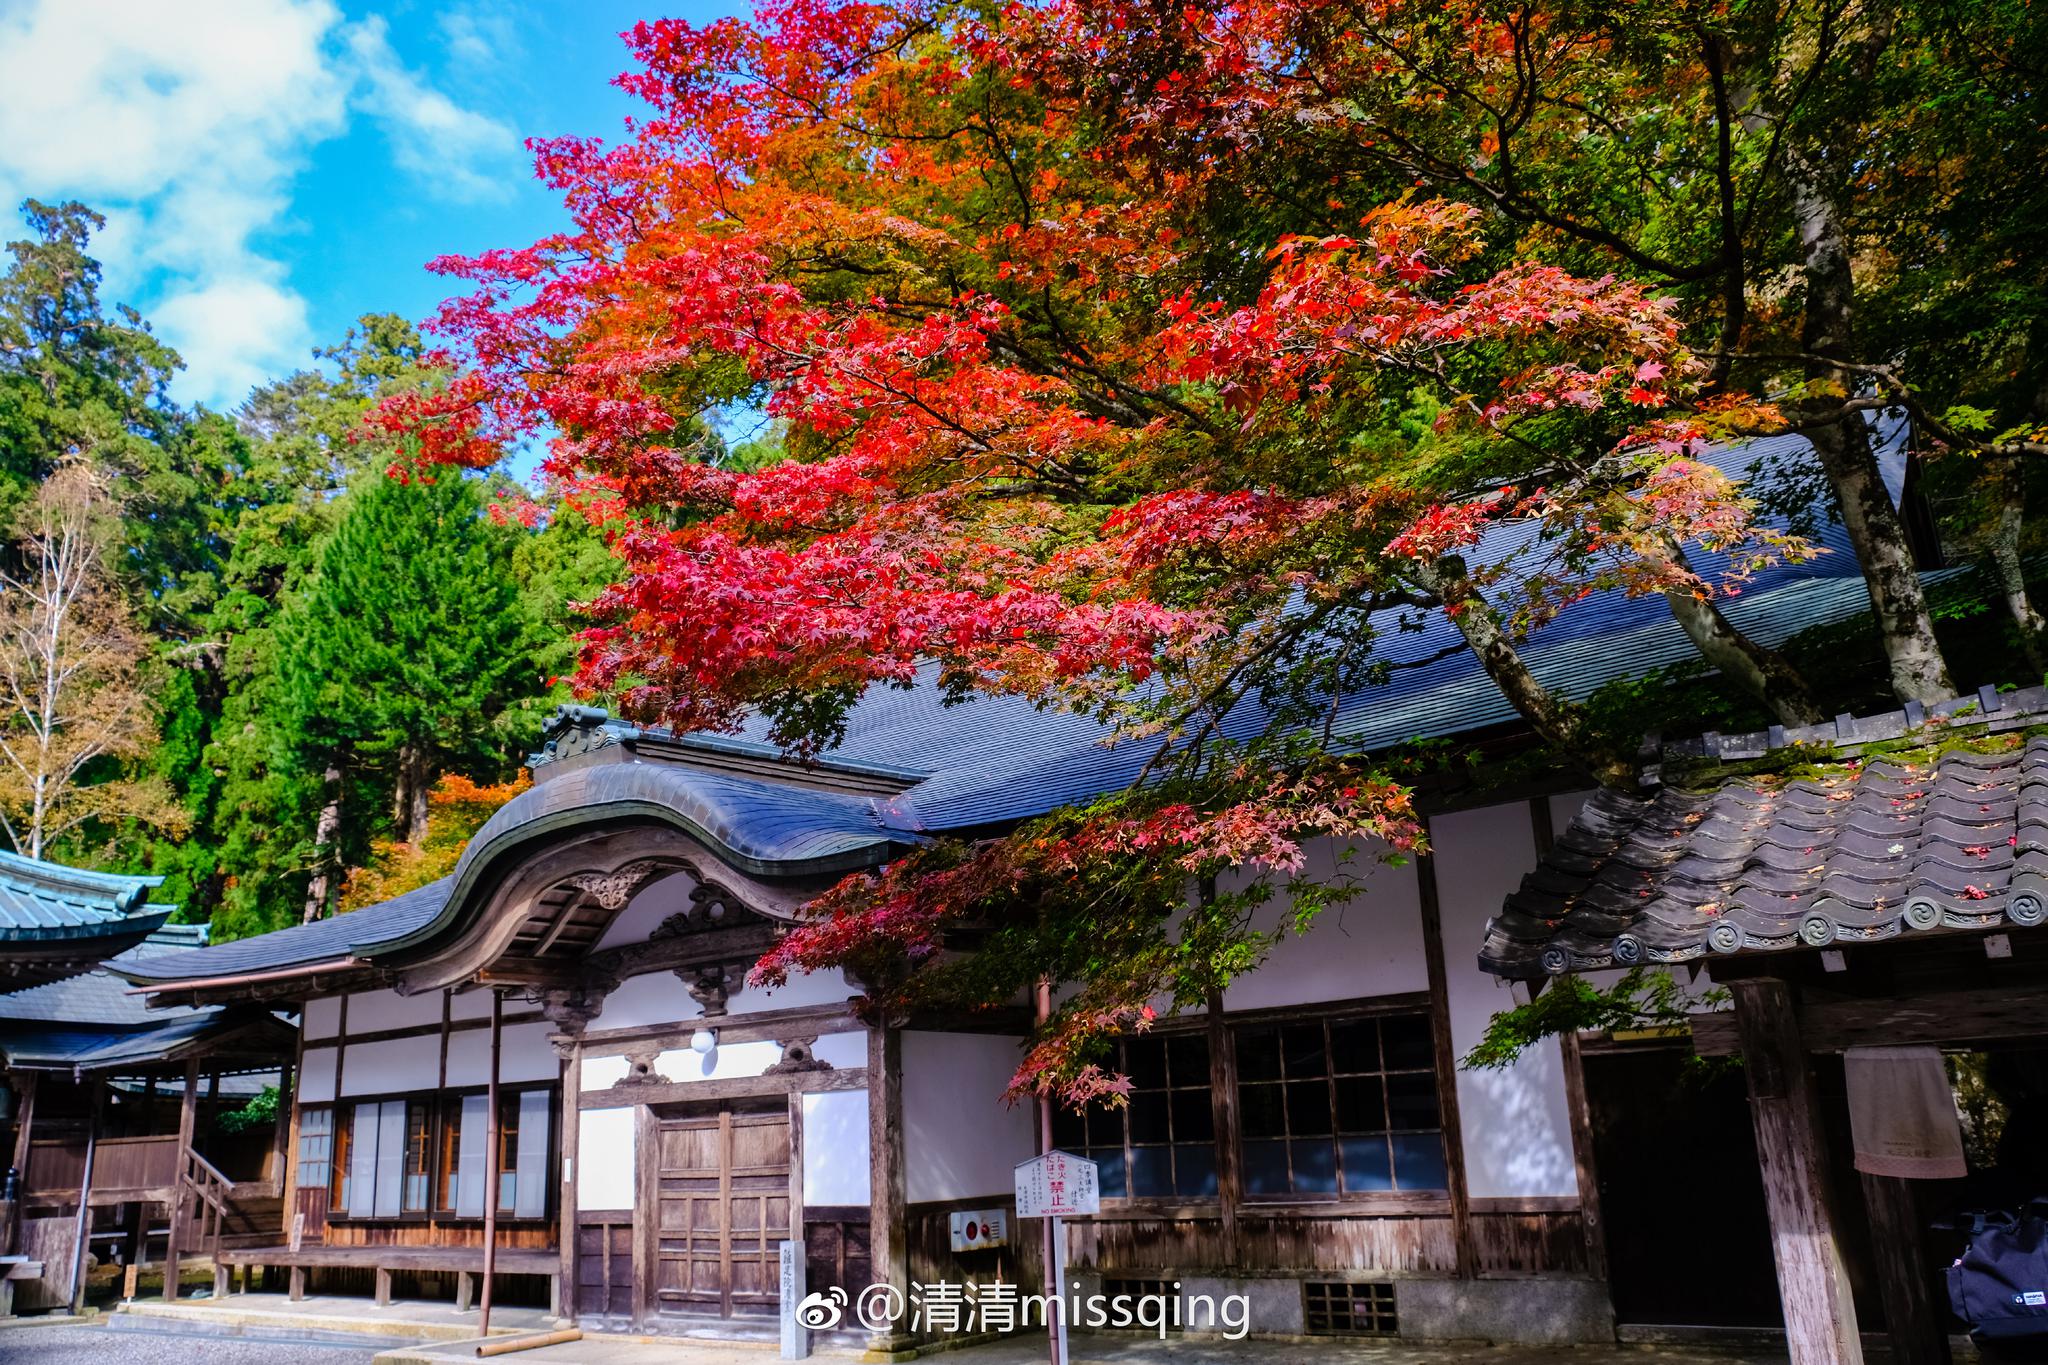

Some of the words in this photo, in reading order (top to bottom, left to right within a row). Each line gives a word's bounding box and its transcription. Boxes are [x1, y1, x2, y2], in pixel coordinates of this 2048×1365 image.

[1057, 1155, 1066, 1179] たき火
[1049, 1181, 1065, 1206] 禁止
